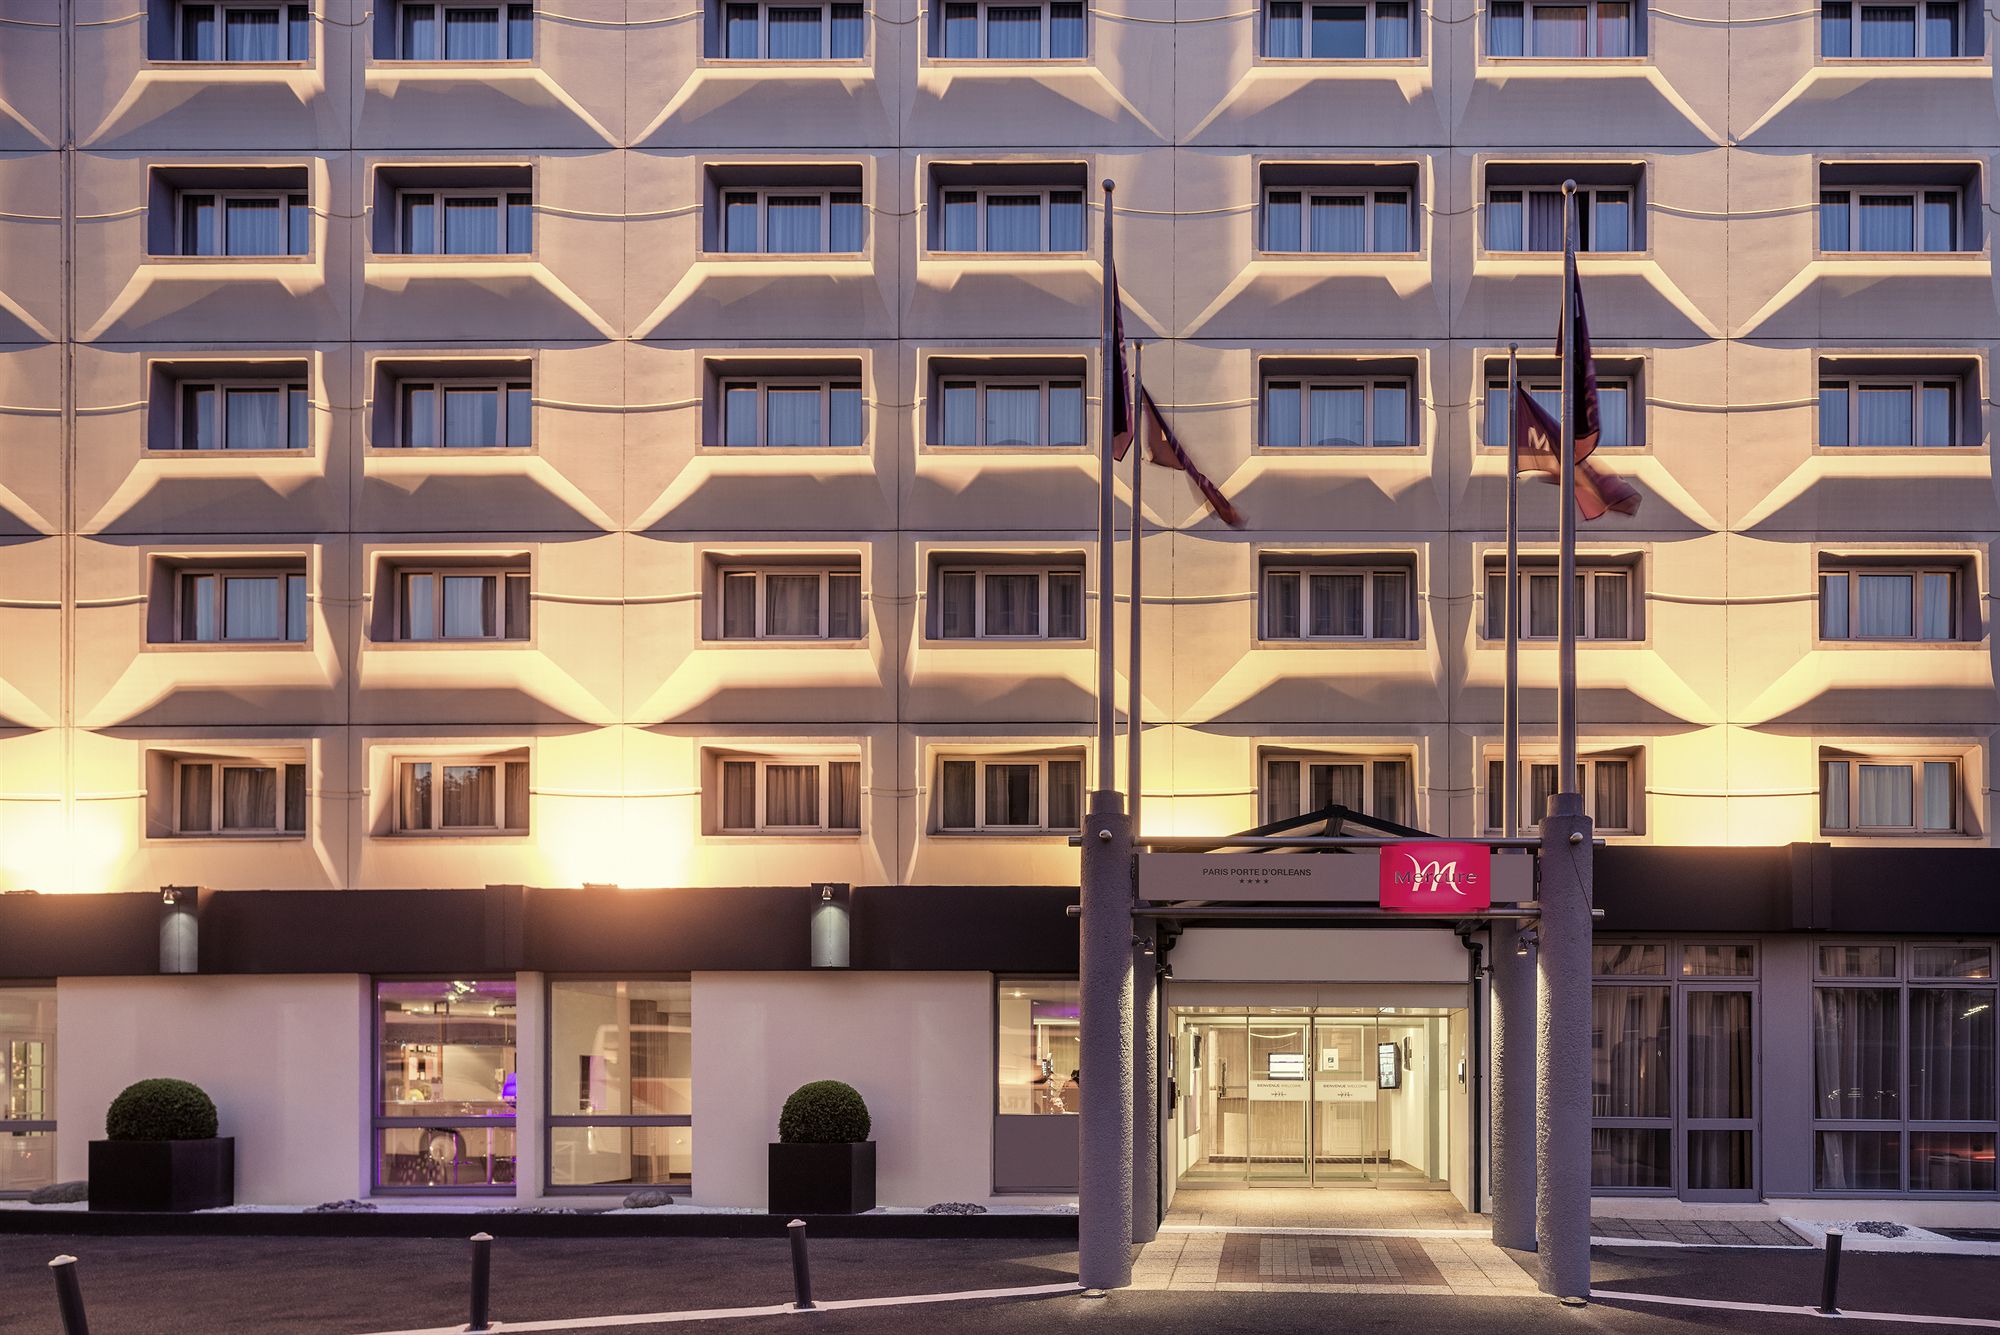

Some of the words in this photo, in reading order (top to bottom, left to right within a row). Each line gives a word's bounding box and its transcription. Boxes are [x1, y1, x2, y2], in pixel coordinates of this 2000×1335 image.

[1202, 868, 1228, 876] PARIS
[1230, 868, 1260, 876] PORTE
[1262, 868, 1312, 876] D'ORLEANS
[1395, 871, 1477, 884] Mercure
